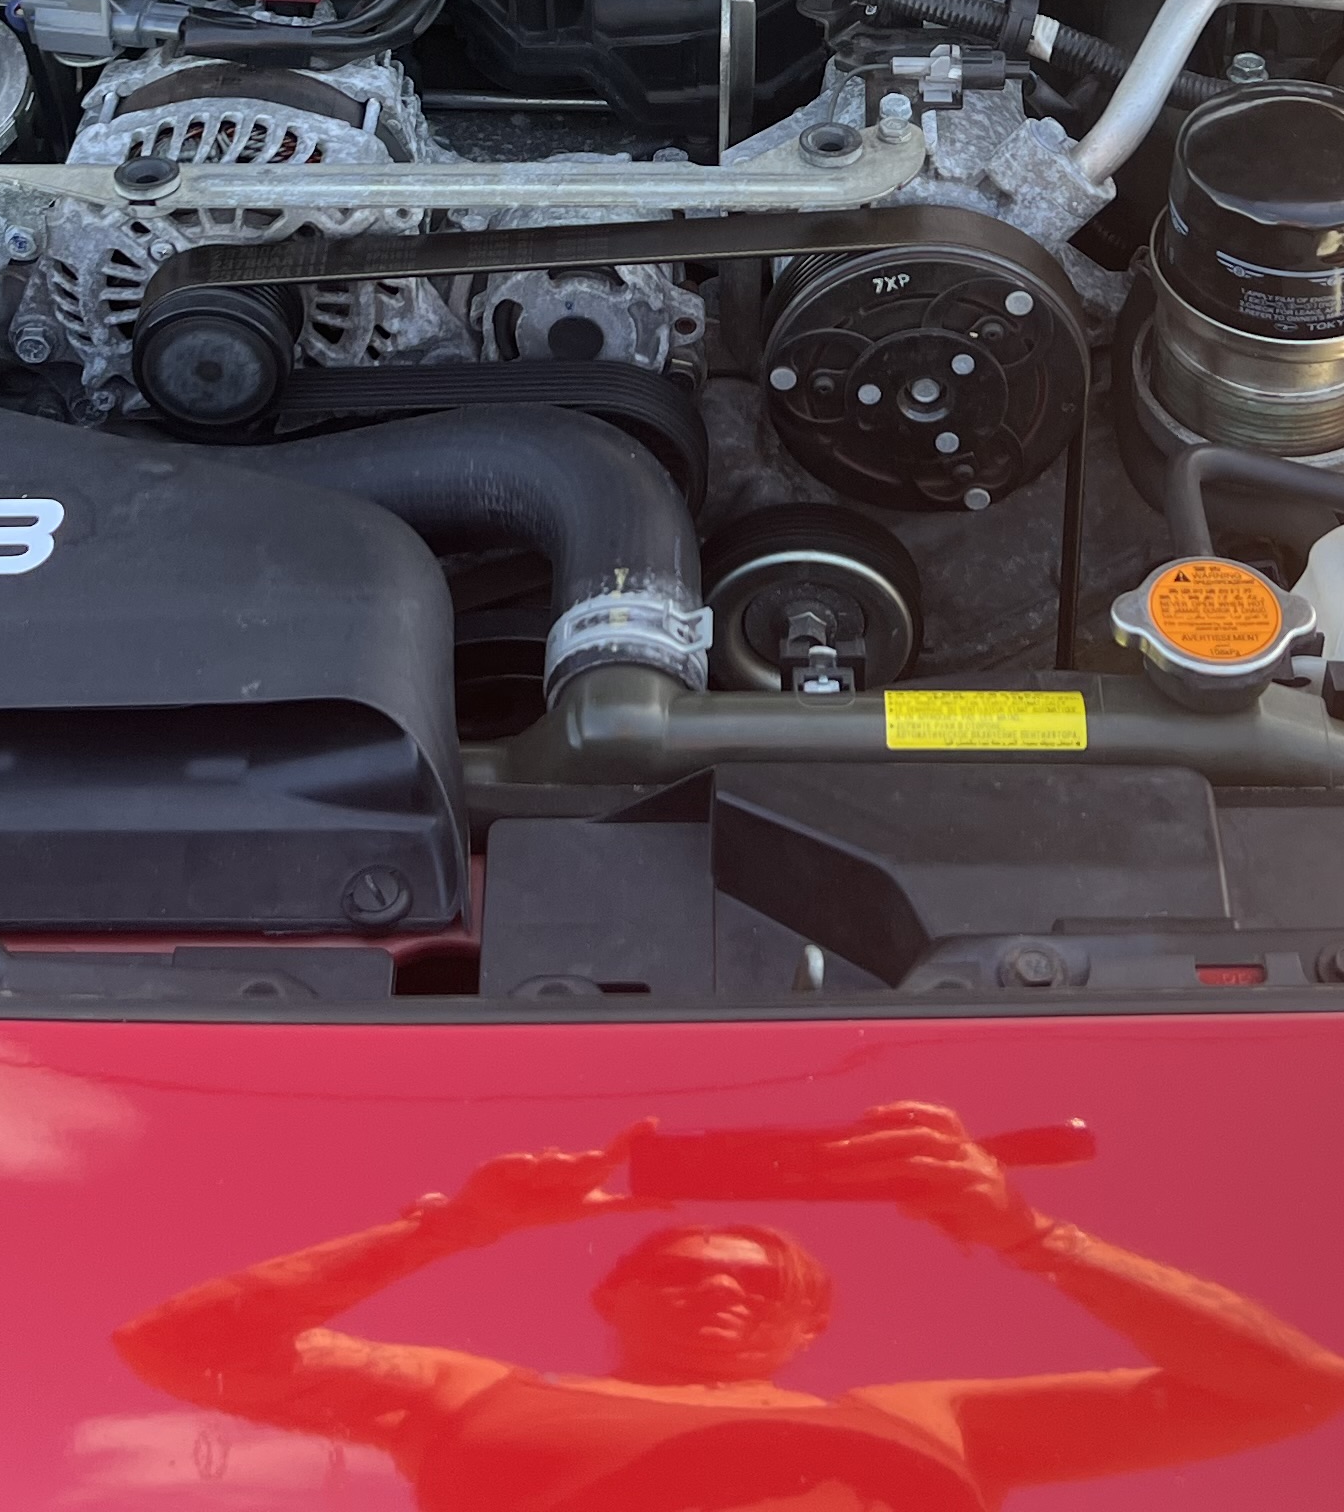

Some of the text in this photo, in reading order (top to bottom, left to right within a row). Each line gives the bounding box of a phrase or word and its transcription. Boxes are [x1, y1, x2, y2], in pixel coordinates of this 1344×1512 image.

[871, 272, 911, 293] 7XP
[1192, 572, 1242, 580] WARNING
[1181, 634, 1259, 642] AVERTISSEMENT
